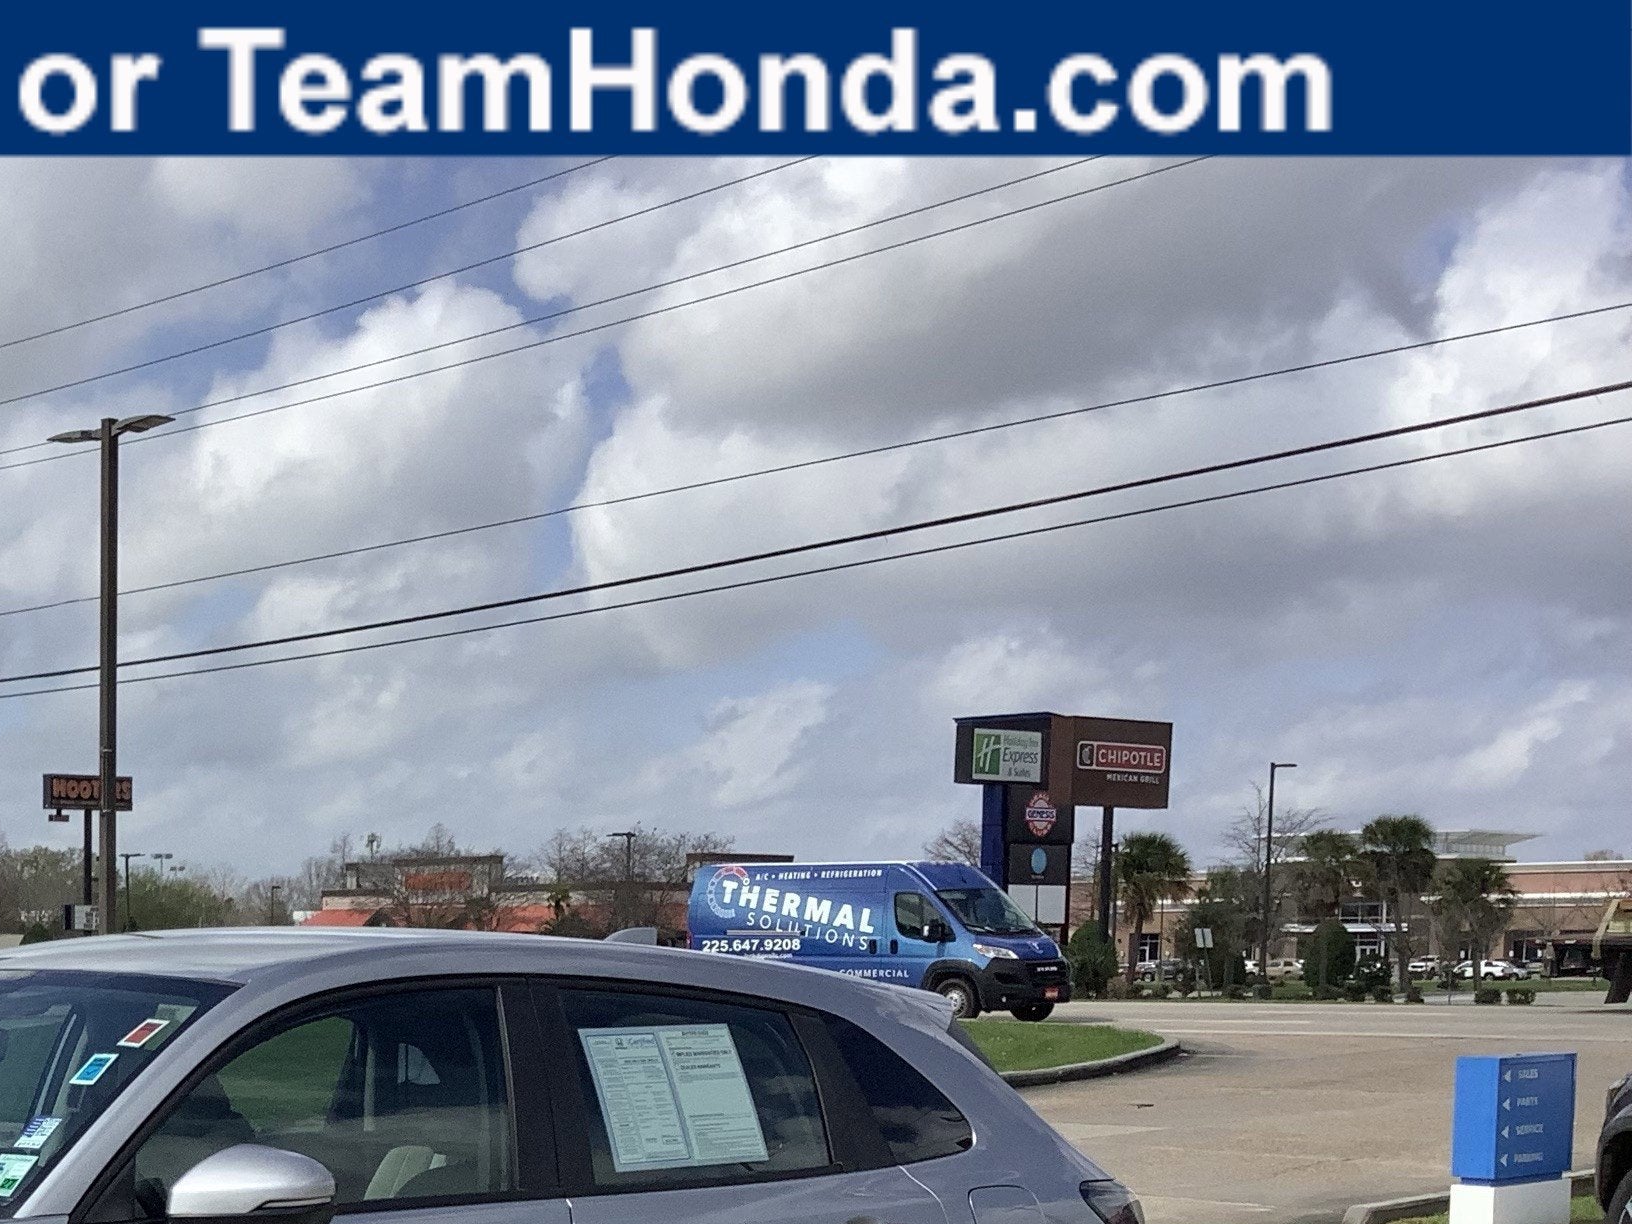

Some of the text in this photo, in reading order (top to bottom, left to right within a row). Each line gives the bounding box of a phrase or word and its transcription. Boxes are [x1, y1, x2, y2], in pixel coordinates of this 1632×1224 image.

[1003, 747, 1039, 766] Express
[1097, 748, 1162, 767] CHIPOTLE
[1106, 772, 1160, 785] MEXICAN GRILL
[52, 778, 131, 800] HOOTRS
[778, 871, 811, 881] HEATING
[820, 869, 883, 880] REFRIGERATION
[722, 879, 875, 935] THERMAL
[746, 911, 869, 951] SOLUTIONS
[701, 938, 802, 952] 225.647.9208
[839, 968, 910, 979] COMMERCIAL
